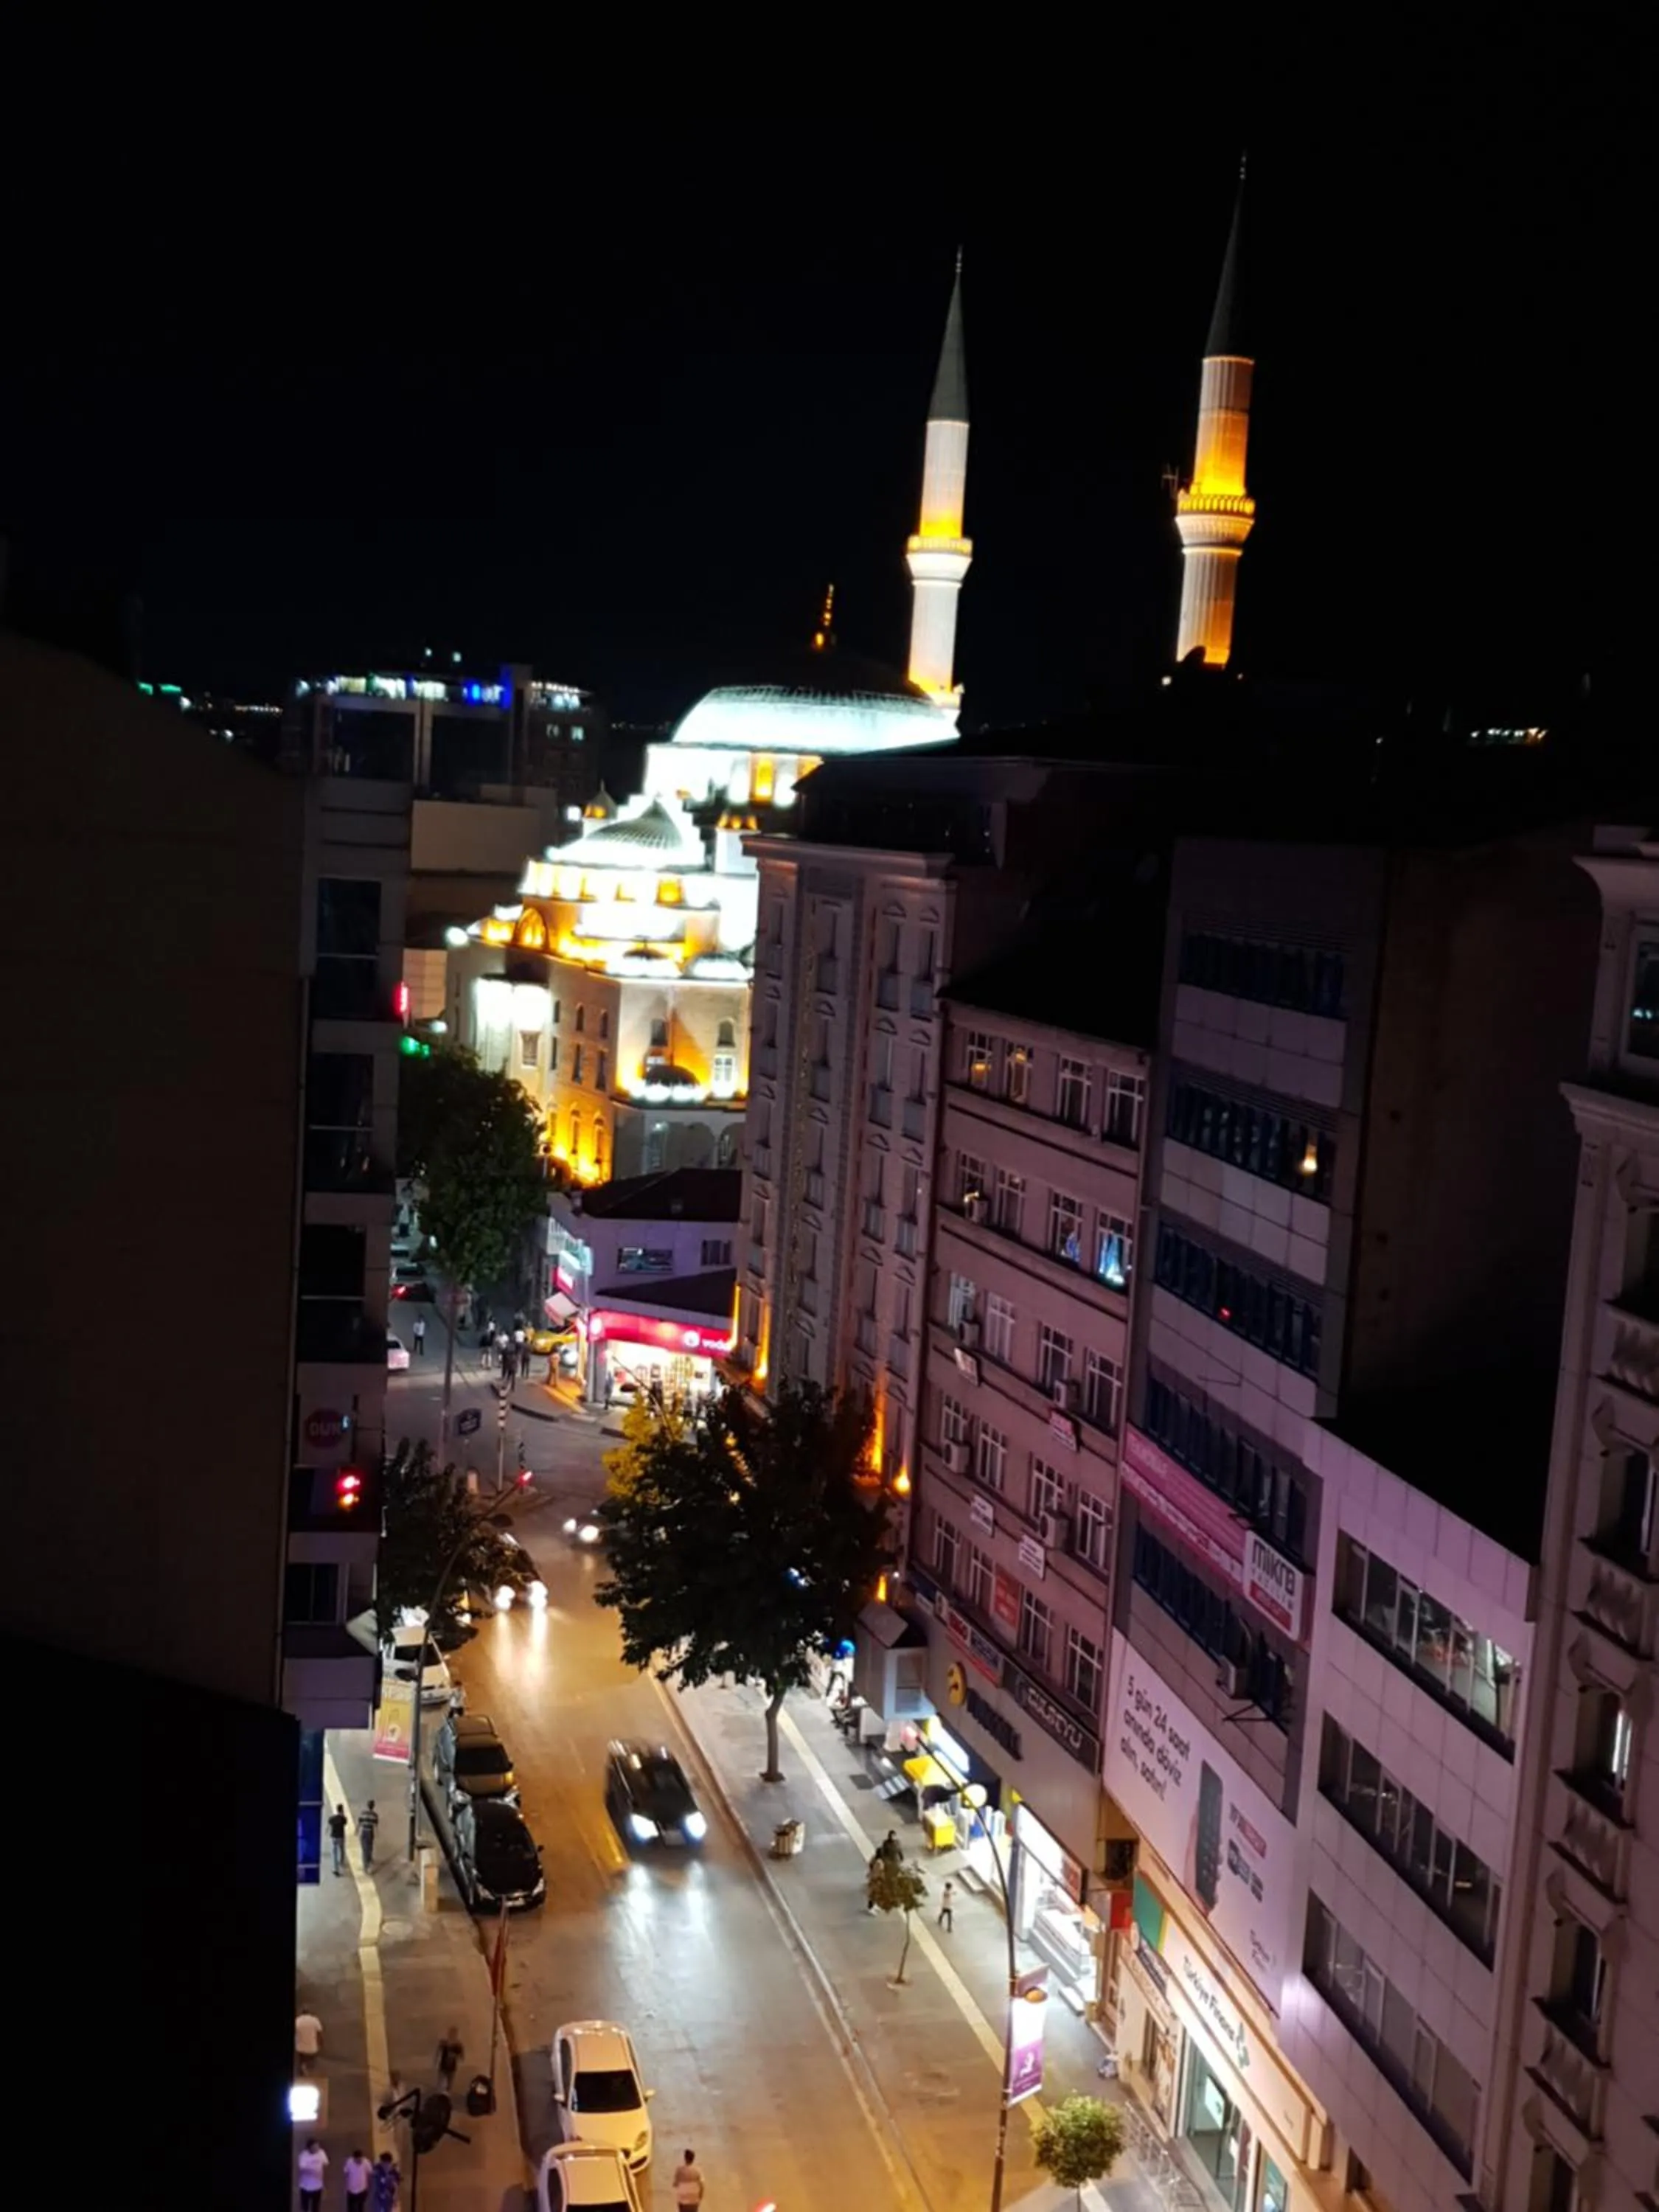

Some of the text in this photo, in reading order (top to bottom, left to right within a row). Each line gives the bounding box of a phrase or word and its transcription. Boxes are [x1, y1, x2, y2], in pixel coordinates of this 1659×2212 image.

[1124, 1708, 1183, 1788] anında döviz
[1127, 1674, 1191, 1761] 5 gün 24 saat
